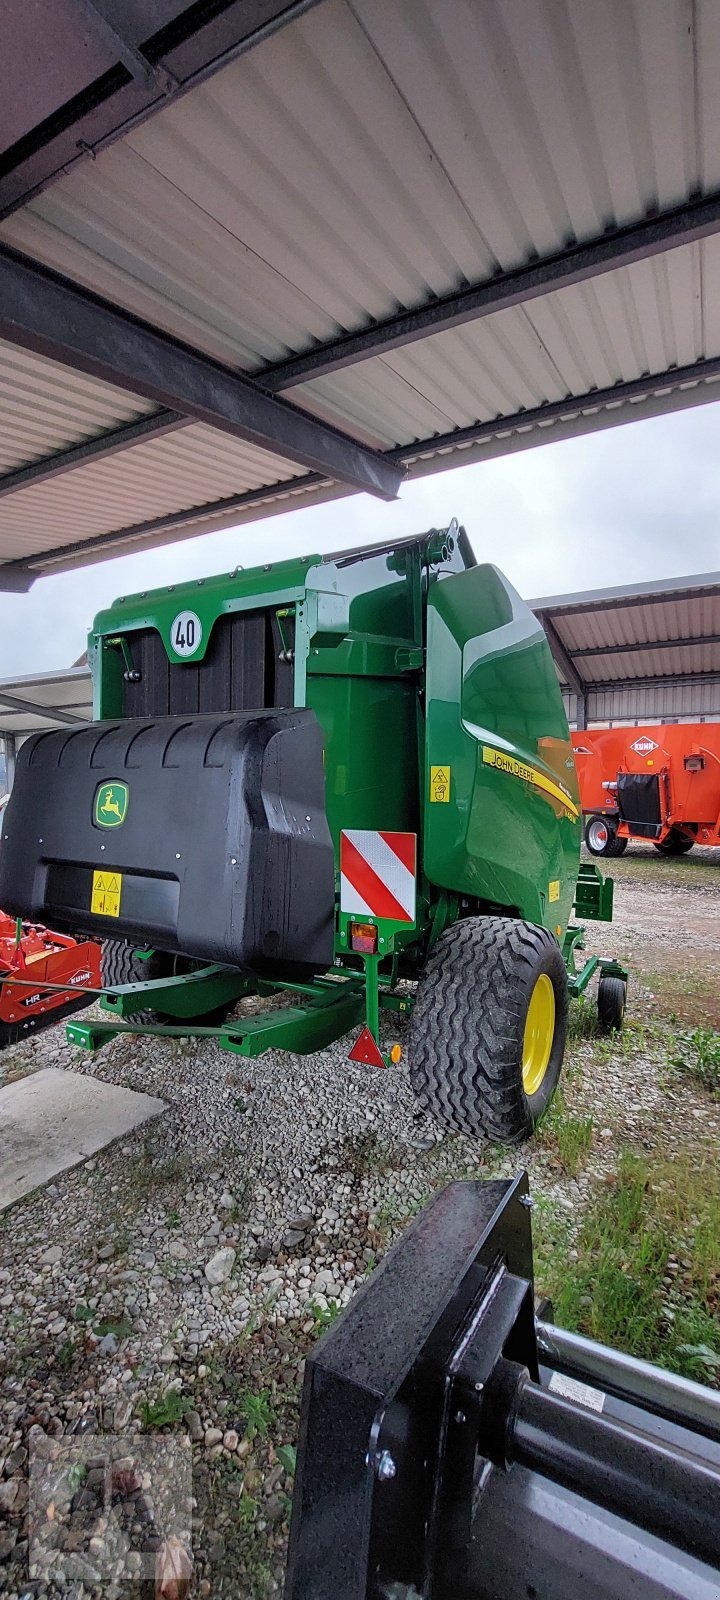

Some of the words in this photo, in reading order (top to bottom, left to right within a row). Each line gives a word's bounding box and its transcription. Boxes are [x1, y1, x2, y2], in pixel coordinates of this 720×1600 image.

[176, 620, 195, 648] 40
[635, 742, 654, 750] KUHN
[491, 753, 513, 772] JOHN
[514, 762, 535, 782] DEERE
[70, 973, 91, 984] KUHN
[25, 994, 40, 1006] HR
